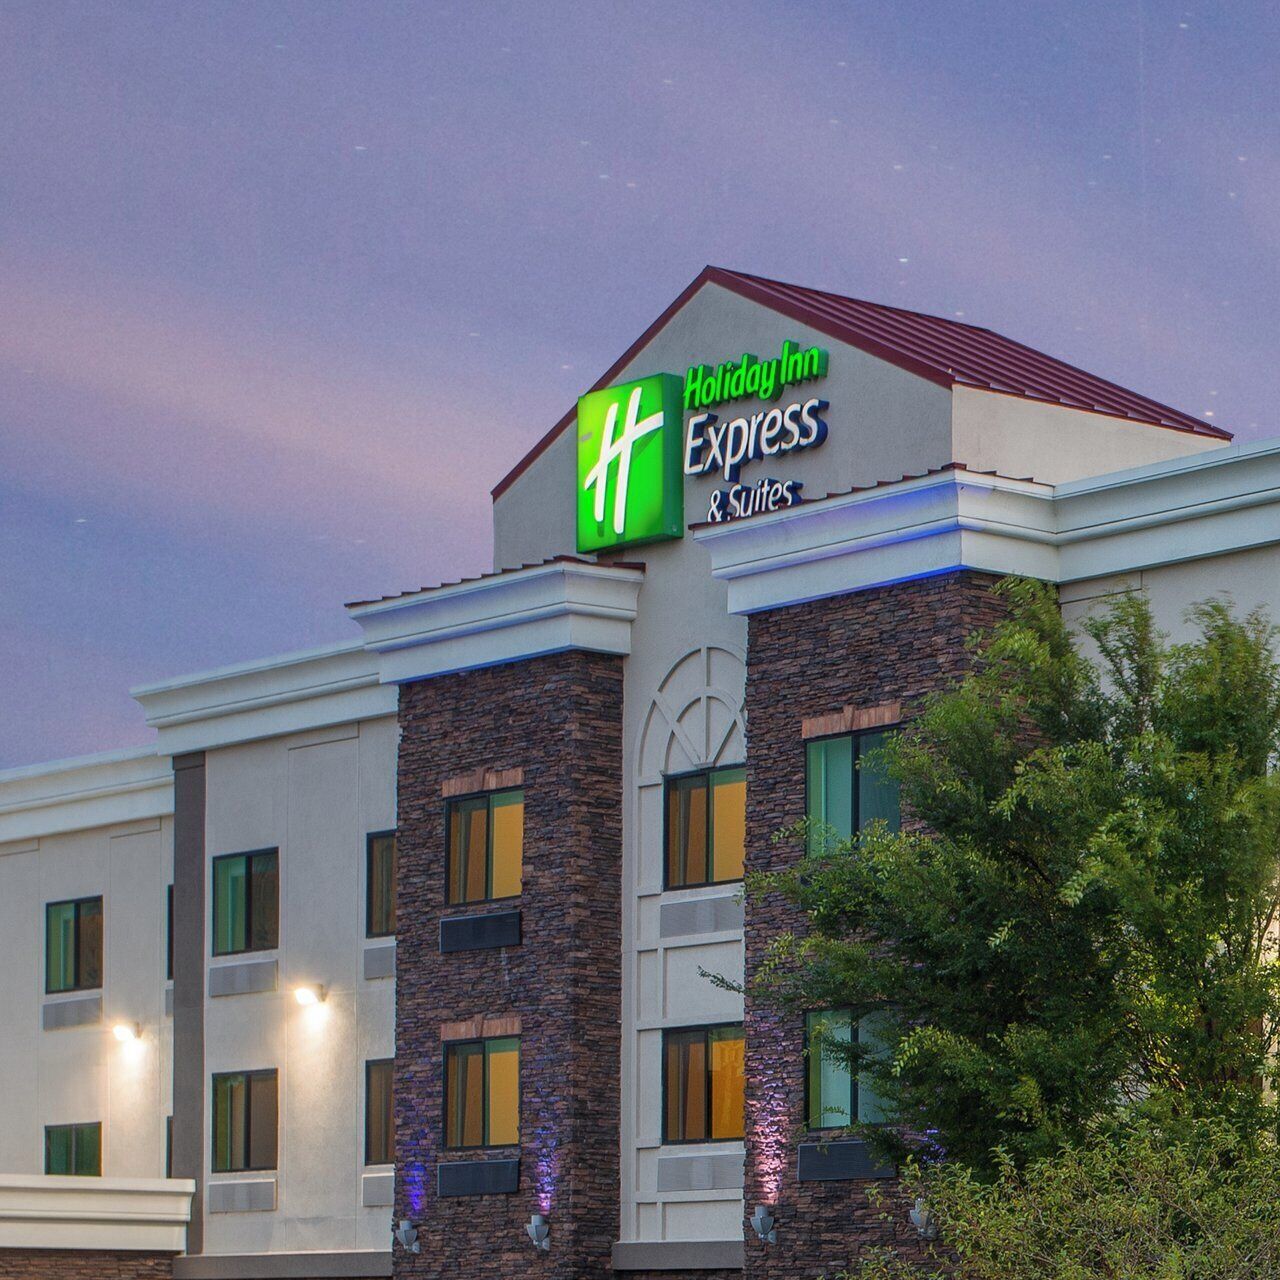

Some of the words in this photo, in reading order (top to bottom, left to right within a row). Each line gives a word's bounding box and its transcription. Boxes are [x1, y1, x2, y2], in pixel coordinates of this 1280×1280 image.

[684, 353, 778, 410] Holiday
[780, 340, 821, 385] Inn
[684, 398, 824, 482] Express
[707, 490, 724, 522] &
[727, 479, 796, 521] Suites
